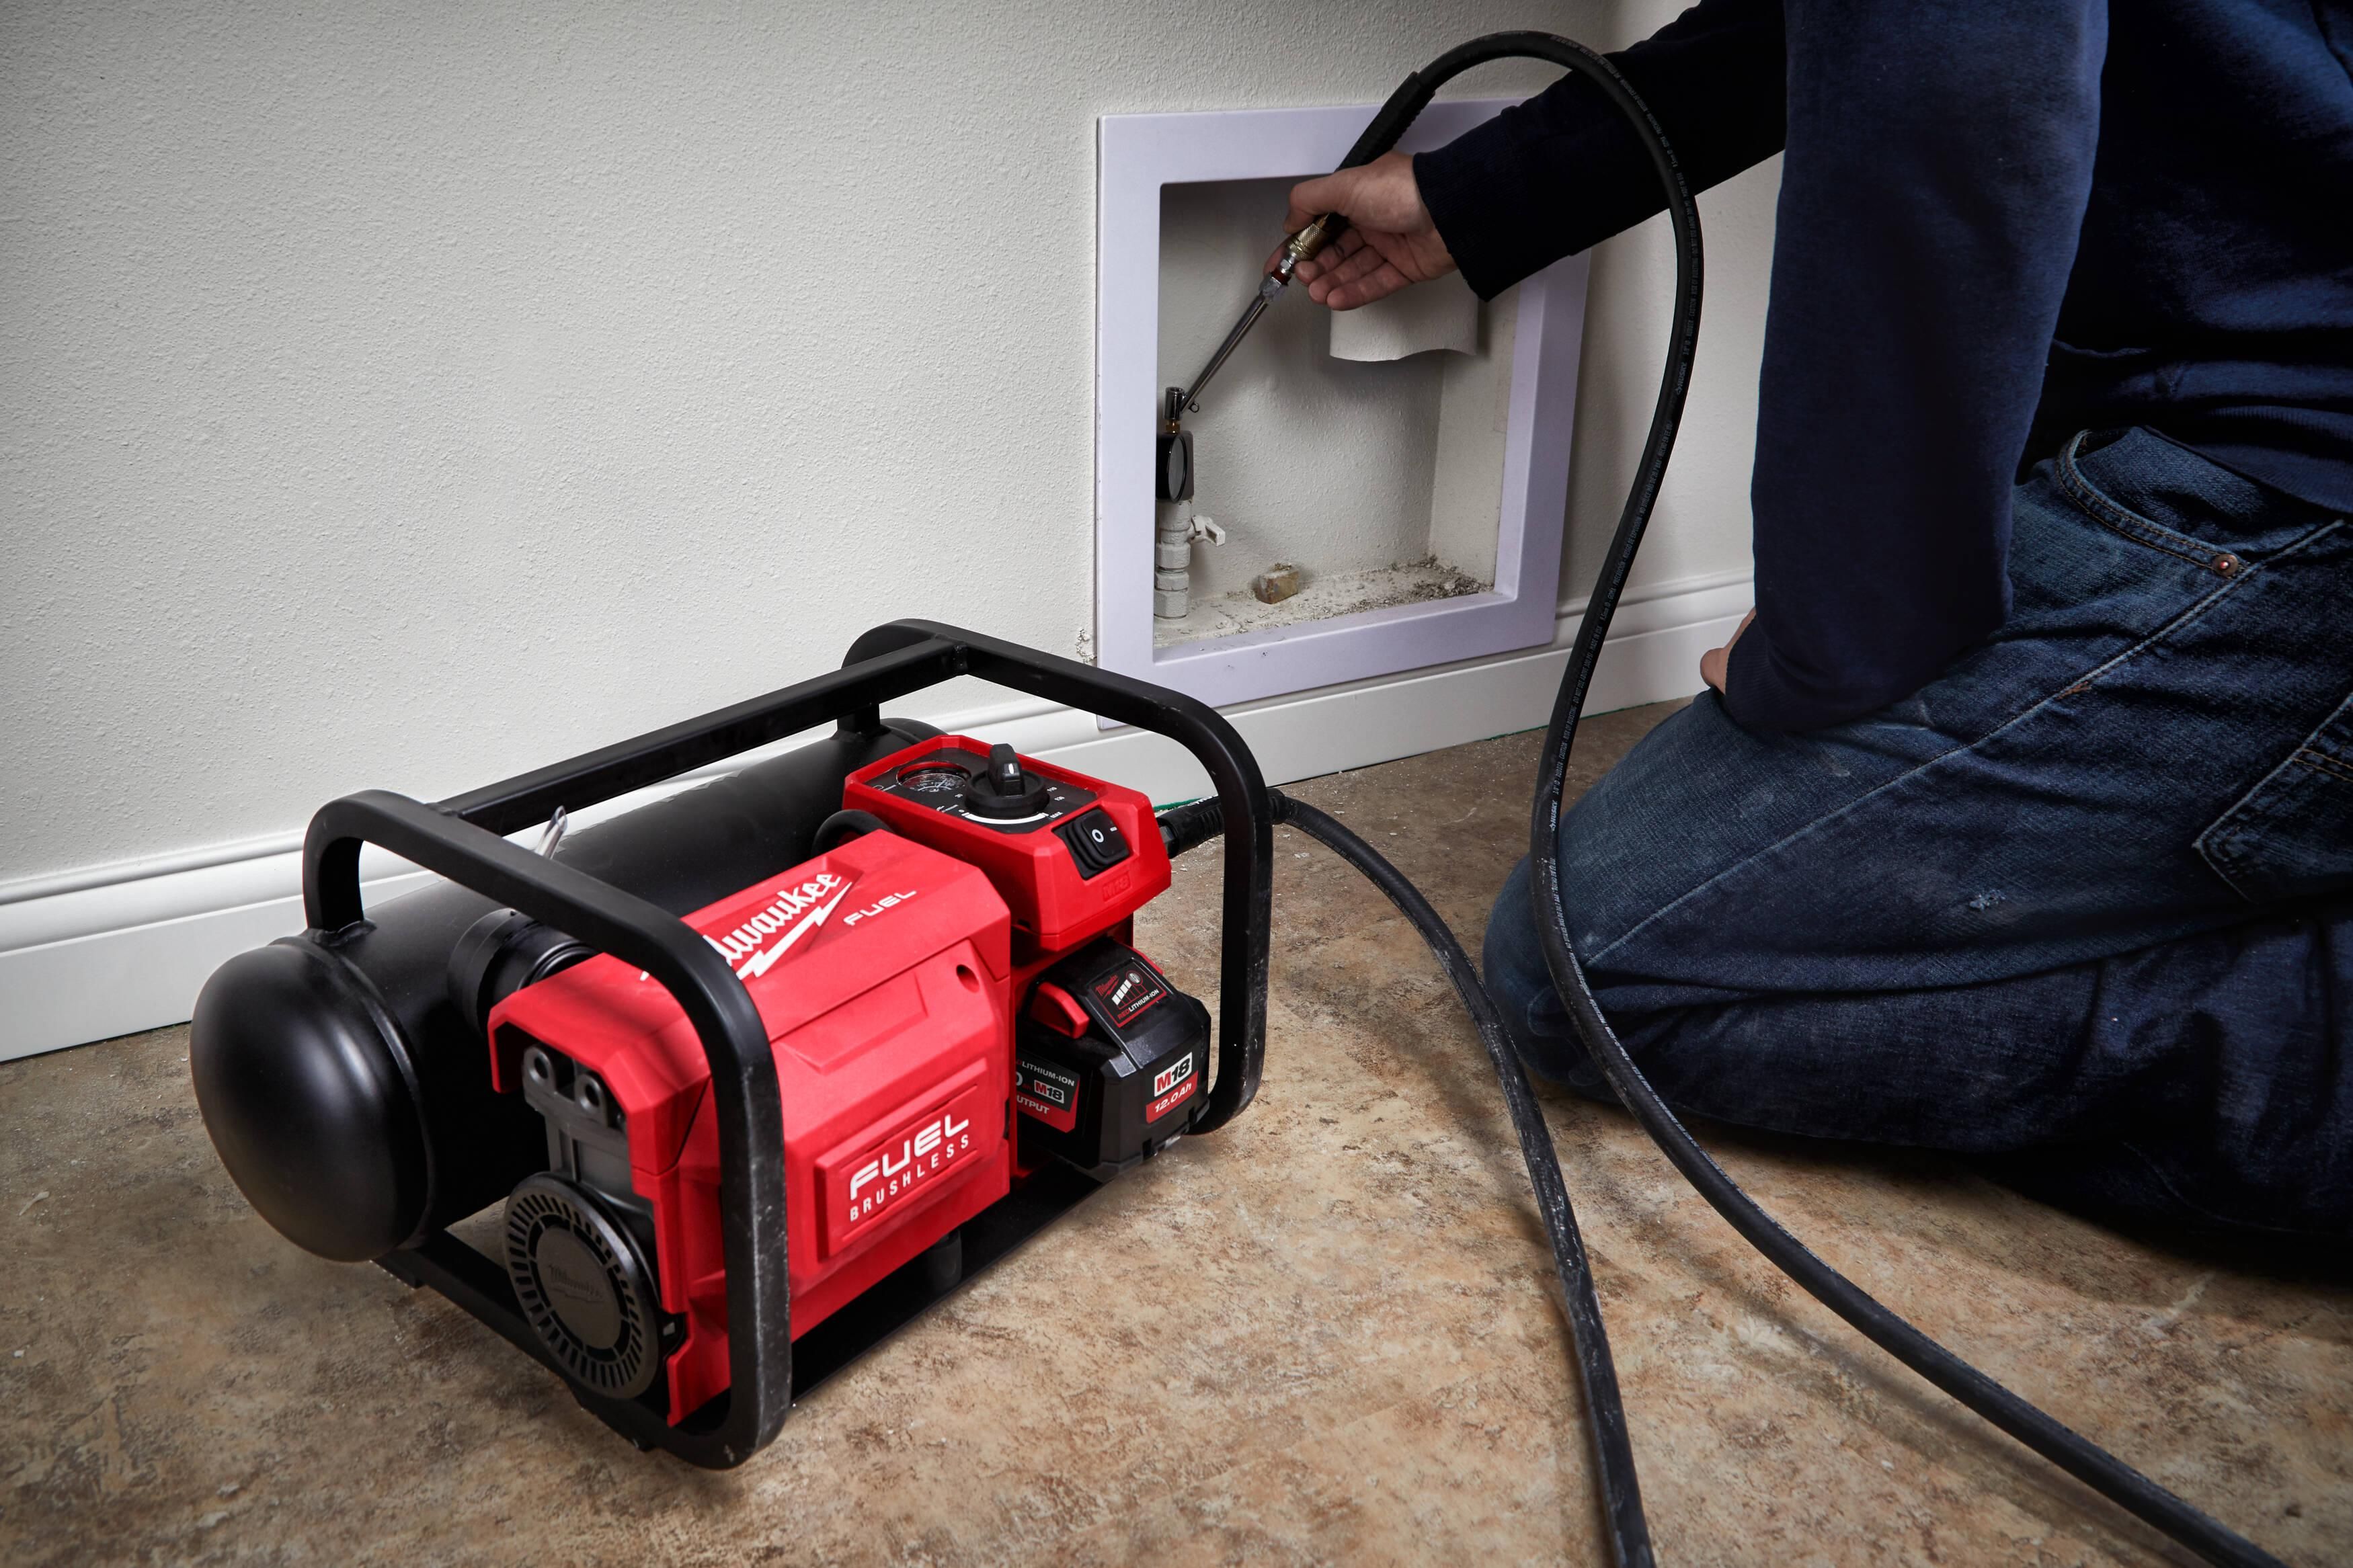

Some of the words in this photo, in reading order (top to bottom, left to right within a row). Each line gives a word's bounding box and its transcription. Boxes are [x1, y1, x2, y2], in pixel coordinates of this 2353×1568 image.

[843, 891, 916, 925] FUEL
[1035, 1081, 1063, 1101] M18
[1157, 1057, 1191, 1093] M18
[1016, 1094, 1049, 1114] UTPUT
[850, 1114, 969, 1201] FUEL
[850, 1134, 969, 1222] BRUSHLESS
